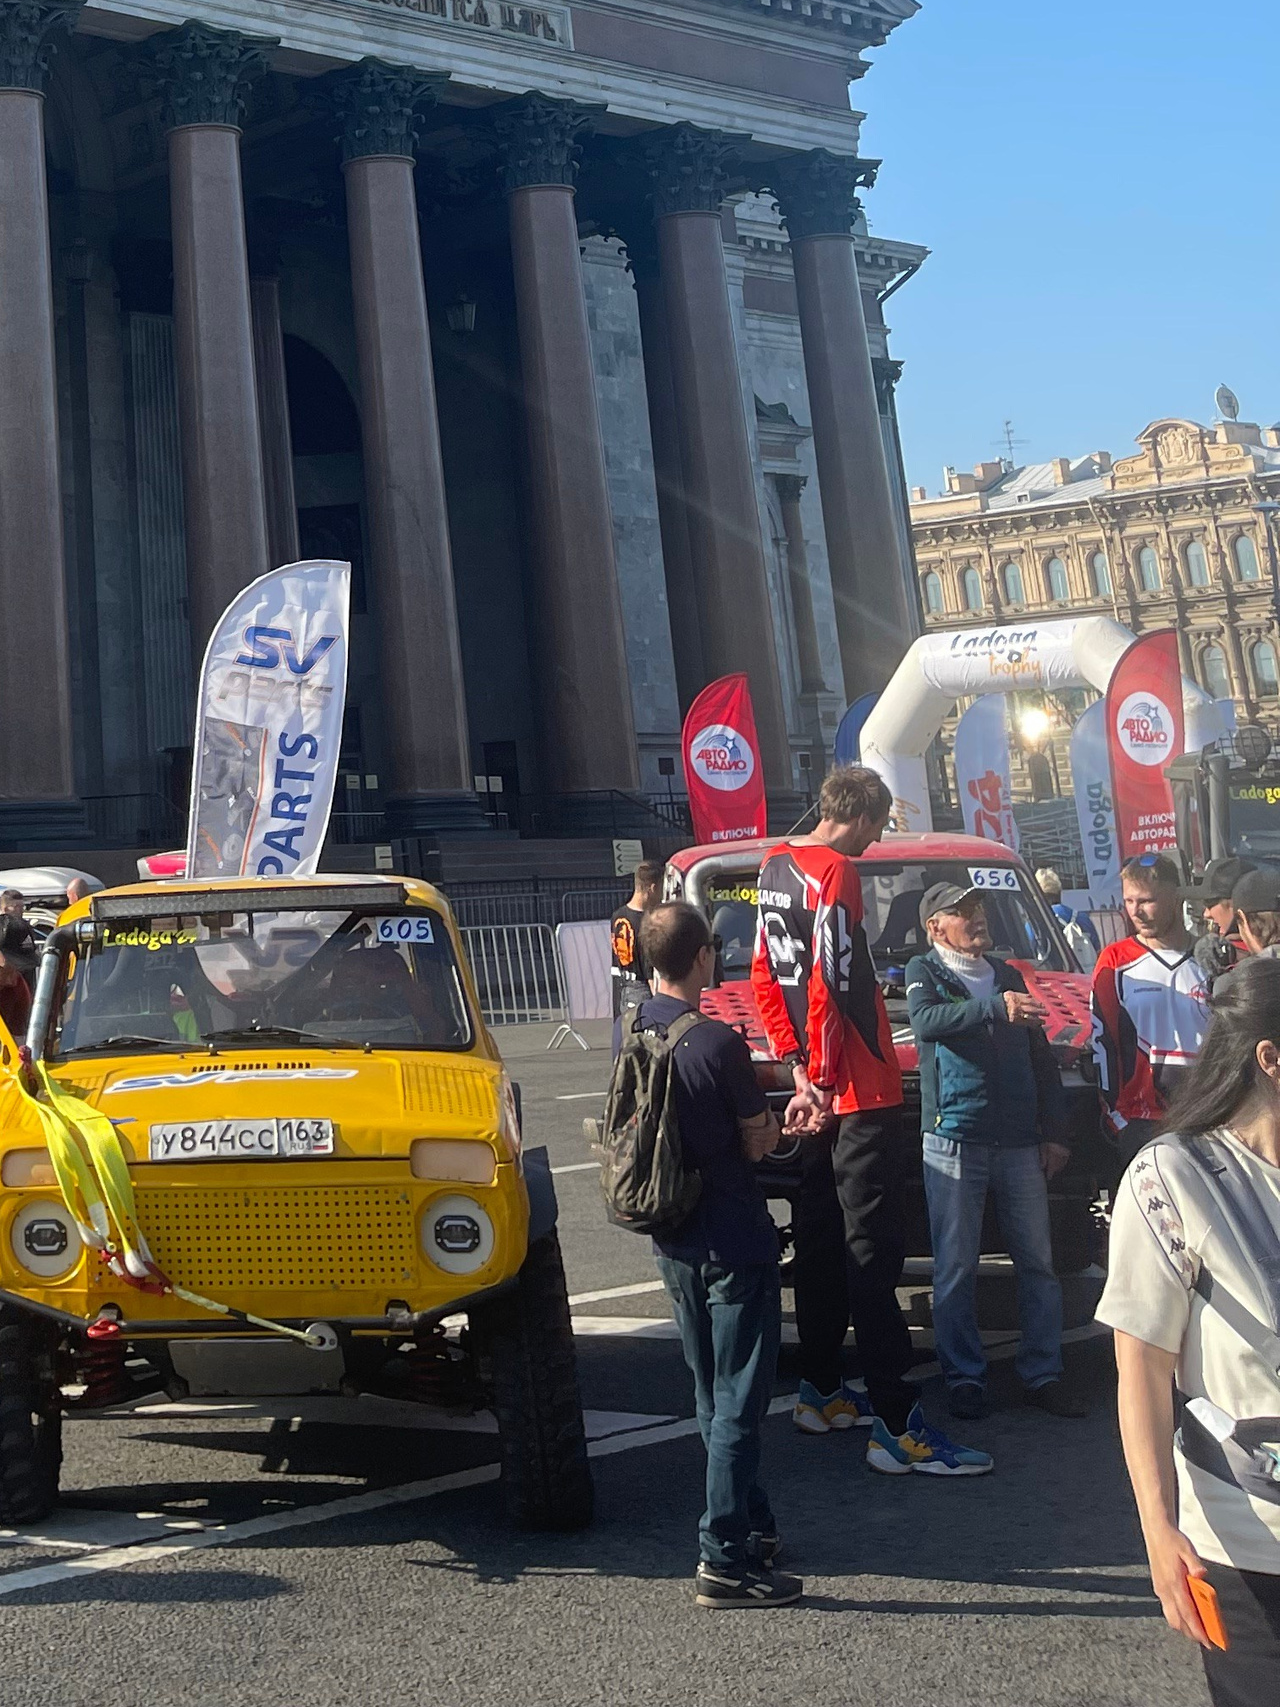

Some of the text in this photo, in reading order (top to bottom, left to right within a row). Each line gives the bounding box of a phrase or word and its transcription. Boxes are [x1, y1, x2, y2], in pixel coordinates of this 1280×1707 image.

[232, 623, 340, 675] SV
[950, 630, 1038, 663] Ladoga
[1120, 718, 1150, 730] АВТО
[1129, 730, 1168, 743] РАДИО
[696, 748, 727, 760] АВТО
[705, 759, 747, 771] РАДИО
[257, 732, 319, 875] PARTS
[712, 826, 758, 841] ВКЛЮЧИ
[1130, 826, 1177, 841] АВТОРАД
[973, 870, 1016, 888] 656
[379, 919, 430, 940] 605
[281, 1120, 324, 1142] 163
[291, 1143, 312, 1151] RUS
